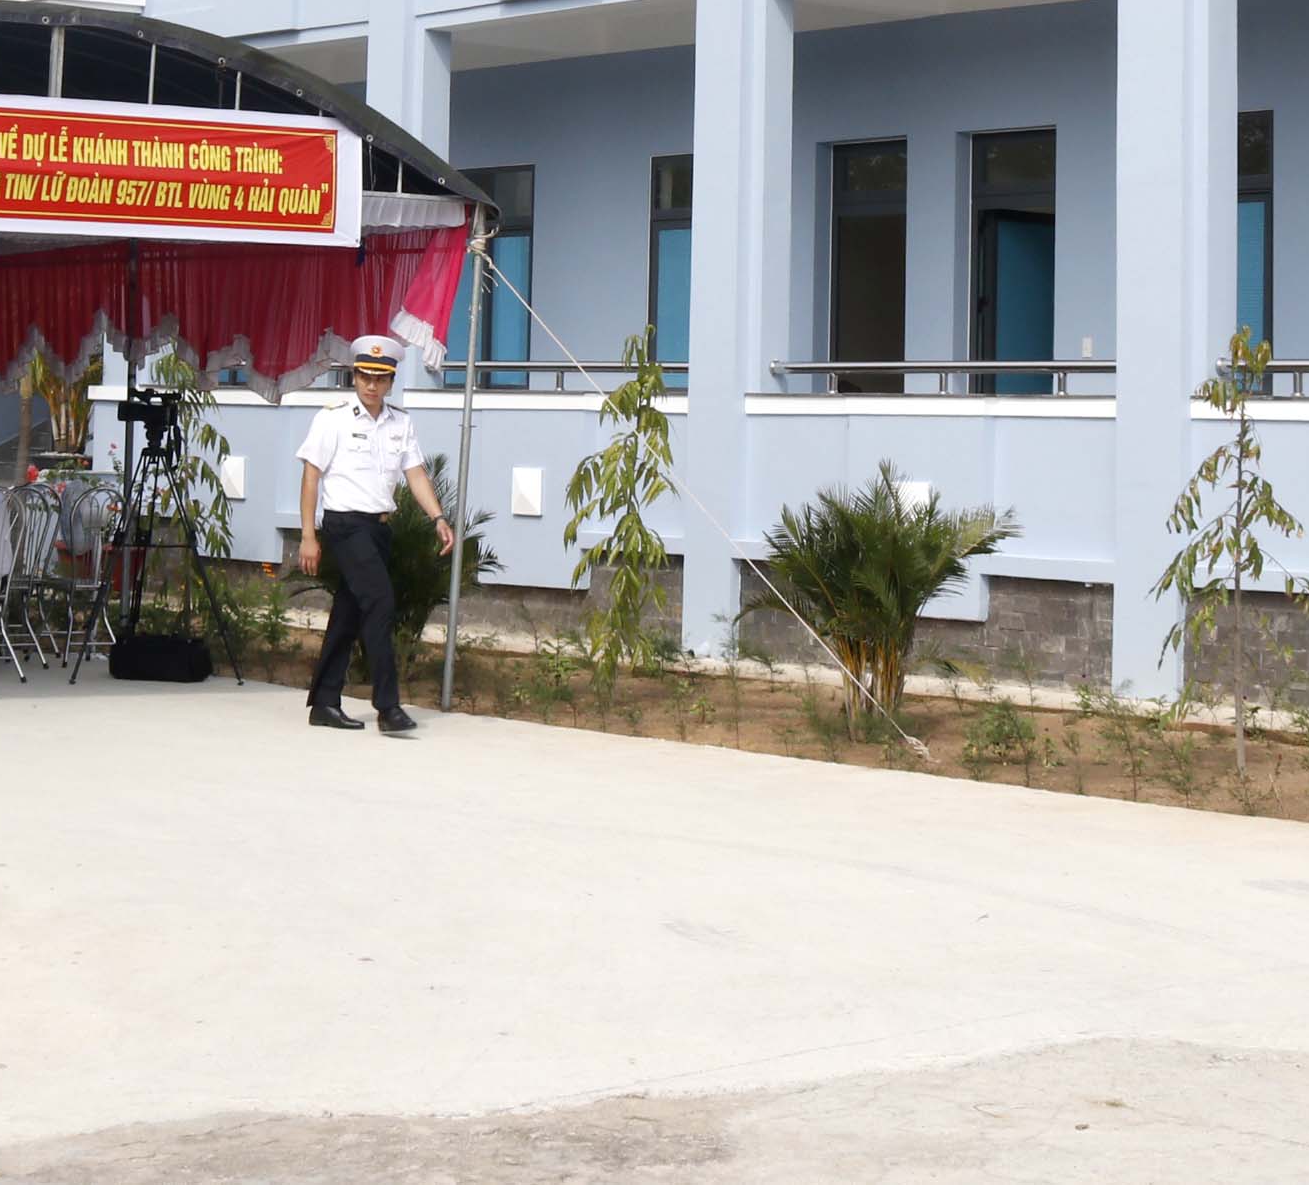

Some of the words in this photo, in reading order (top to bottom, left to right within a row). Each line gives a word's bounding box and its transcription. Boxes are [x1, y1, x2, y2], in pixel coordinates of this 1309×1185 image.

[23, 132, 47, 167] DỰ
[50, 127, 68, 162] LỄ
[73, 133, 128, 166] KHÁNH
[132, 136, 184, 169] THÀNH
[189, 140, 231, 171] CÔNG
[235, 142, 282, 174] TRÌNH:
[66, 173, 113, 203] ĐOÀN
[155, 182, 182, 207] BTL
[189, 178, 231, 210] VÙNG
[234, 187, 244, 210] 4
[248, 179, 275, 212] HẢI
